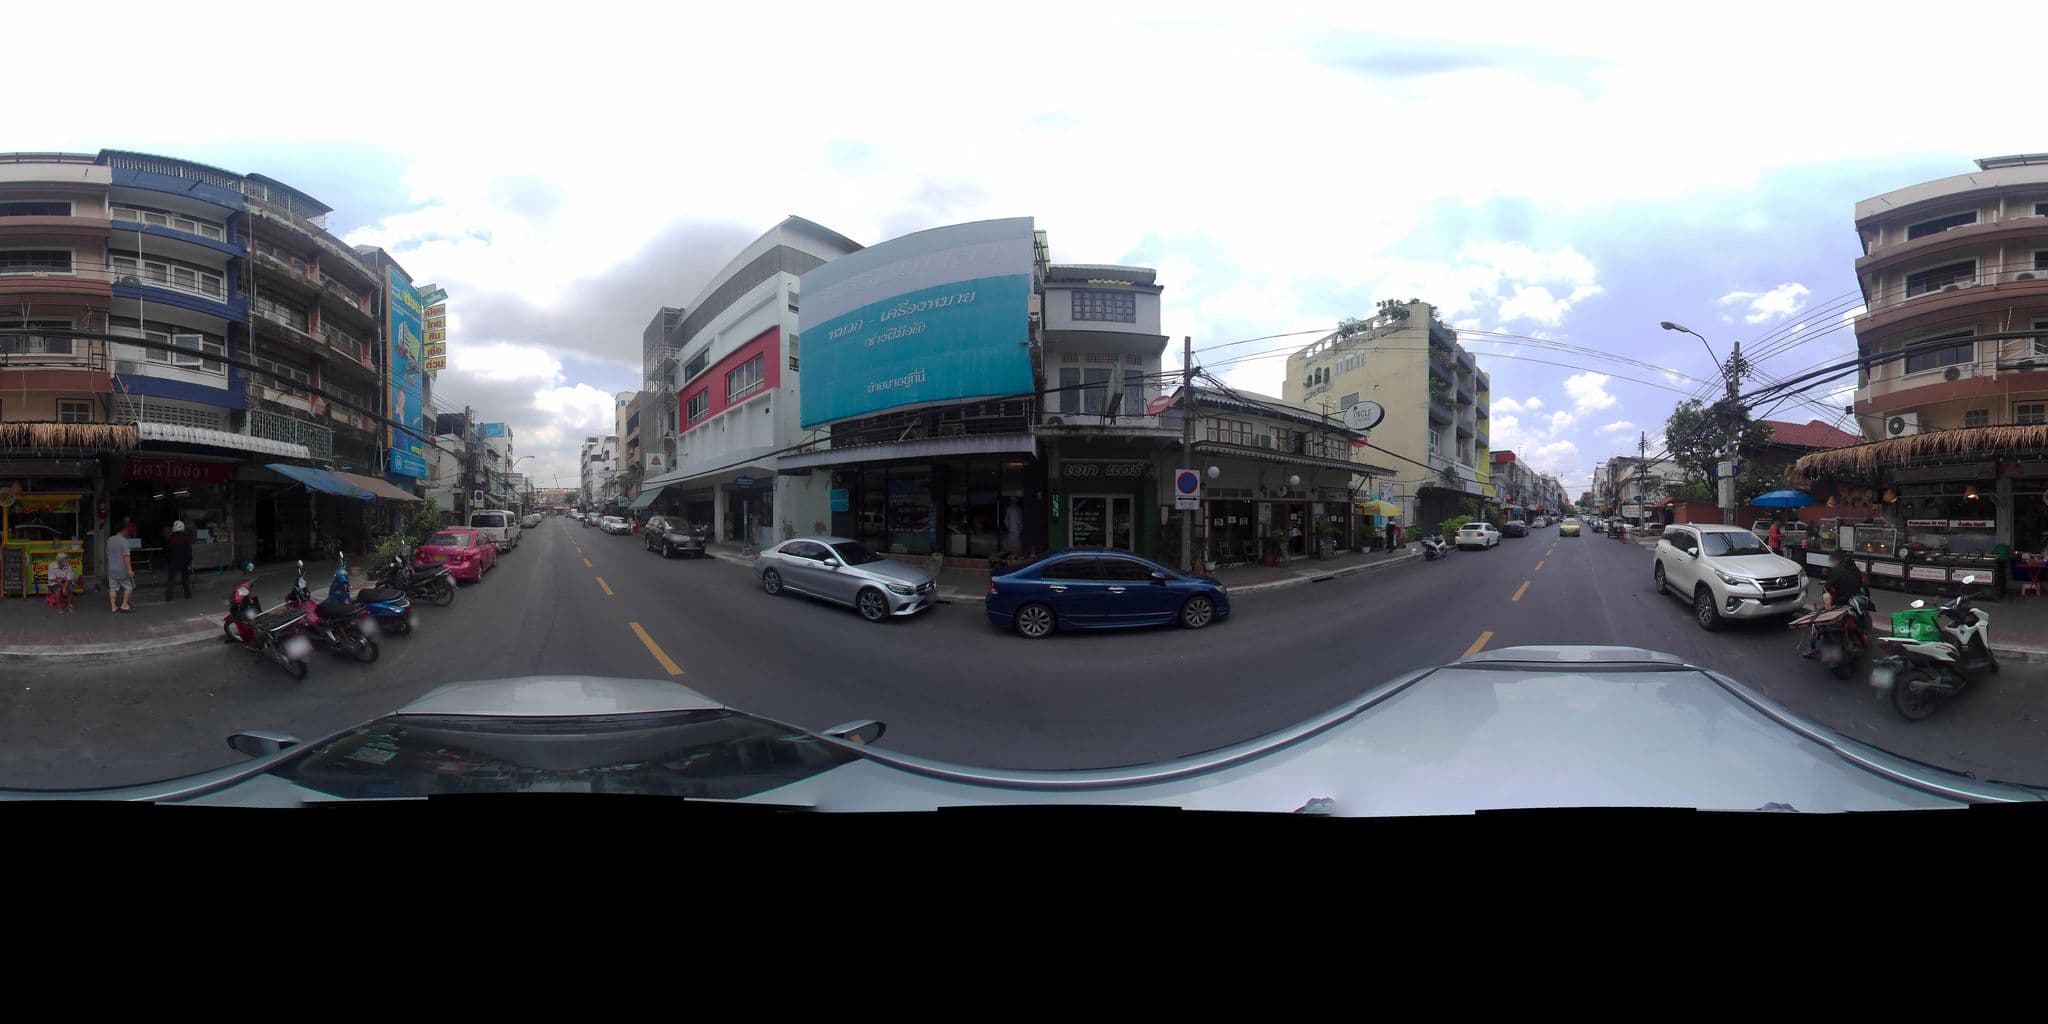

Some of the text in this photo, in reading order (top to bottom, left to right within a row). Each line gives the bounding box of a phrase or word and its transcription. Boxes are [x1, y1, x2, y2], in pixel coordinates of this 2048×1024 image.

[880, 291, 976, 322] เครื่องหมาย
